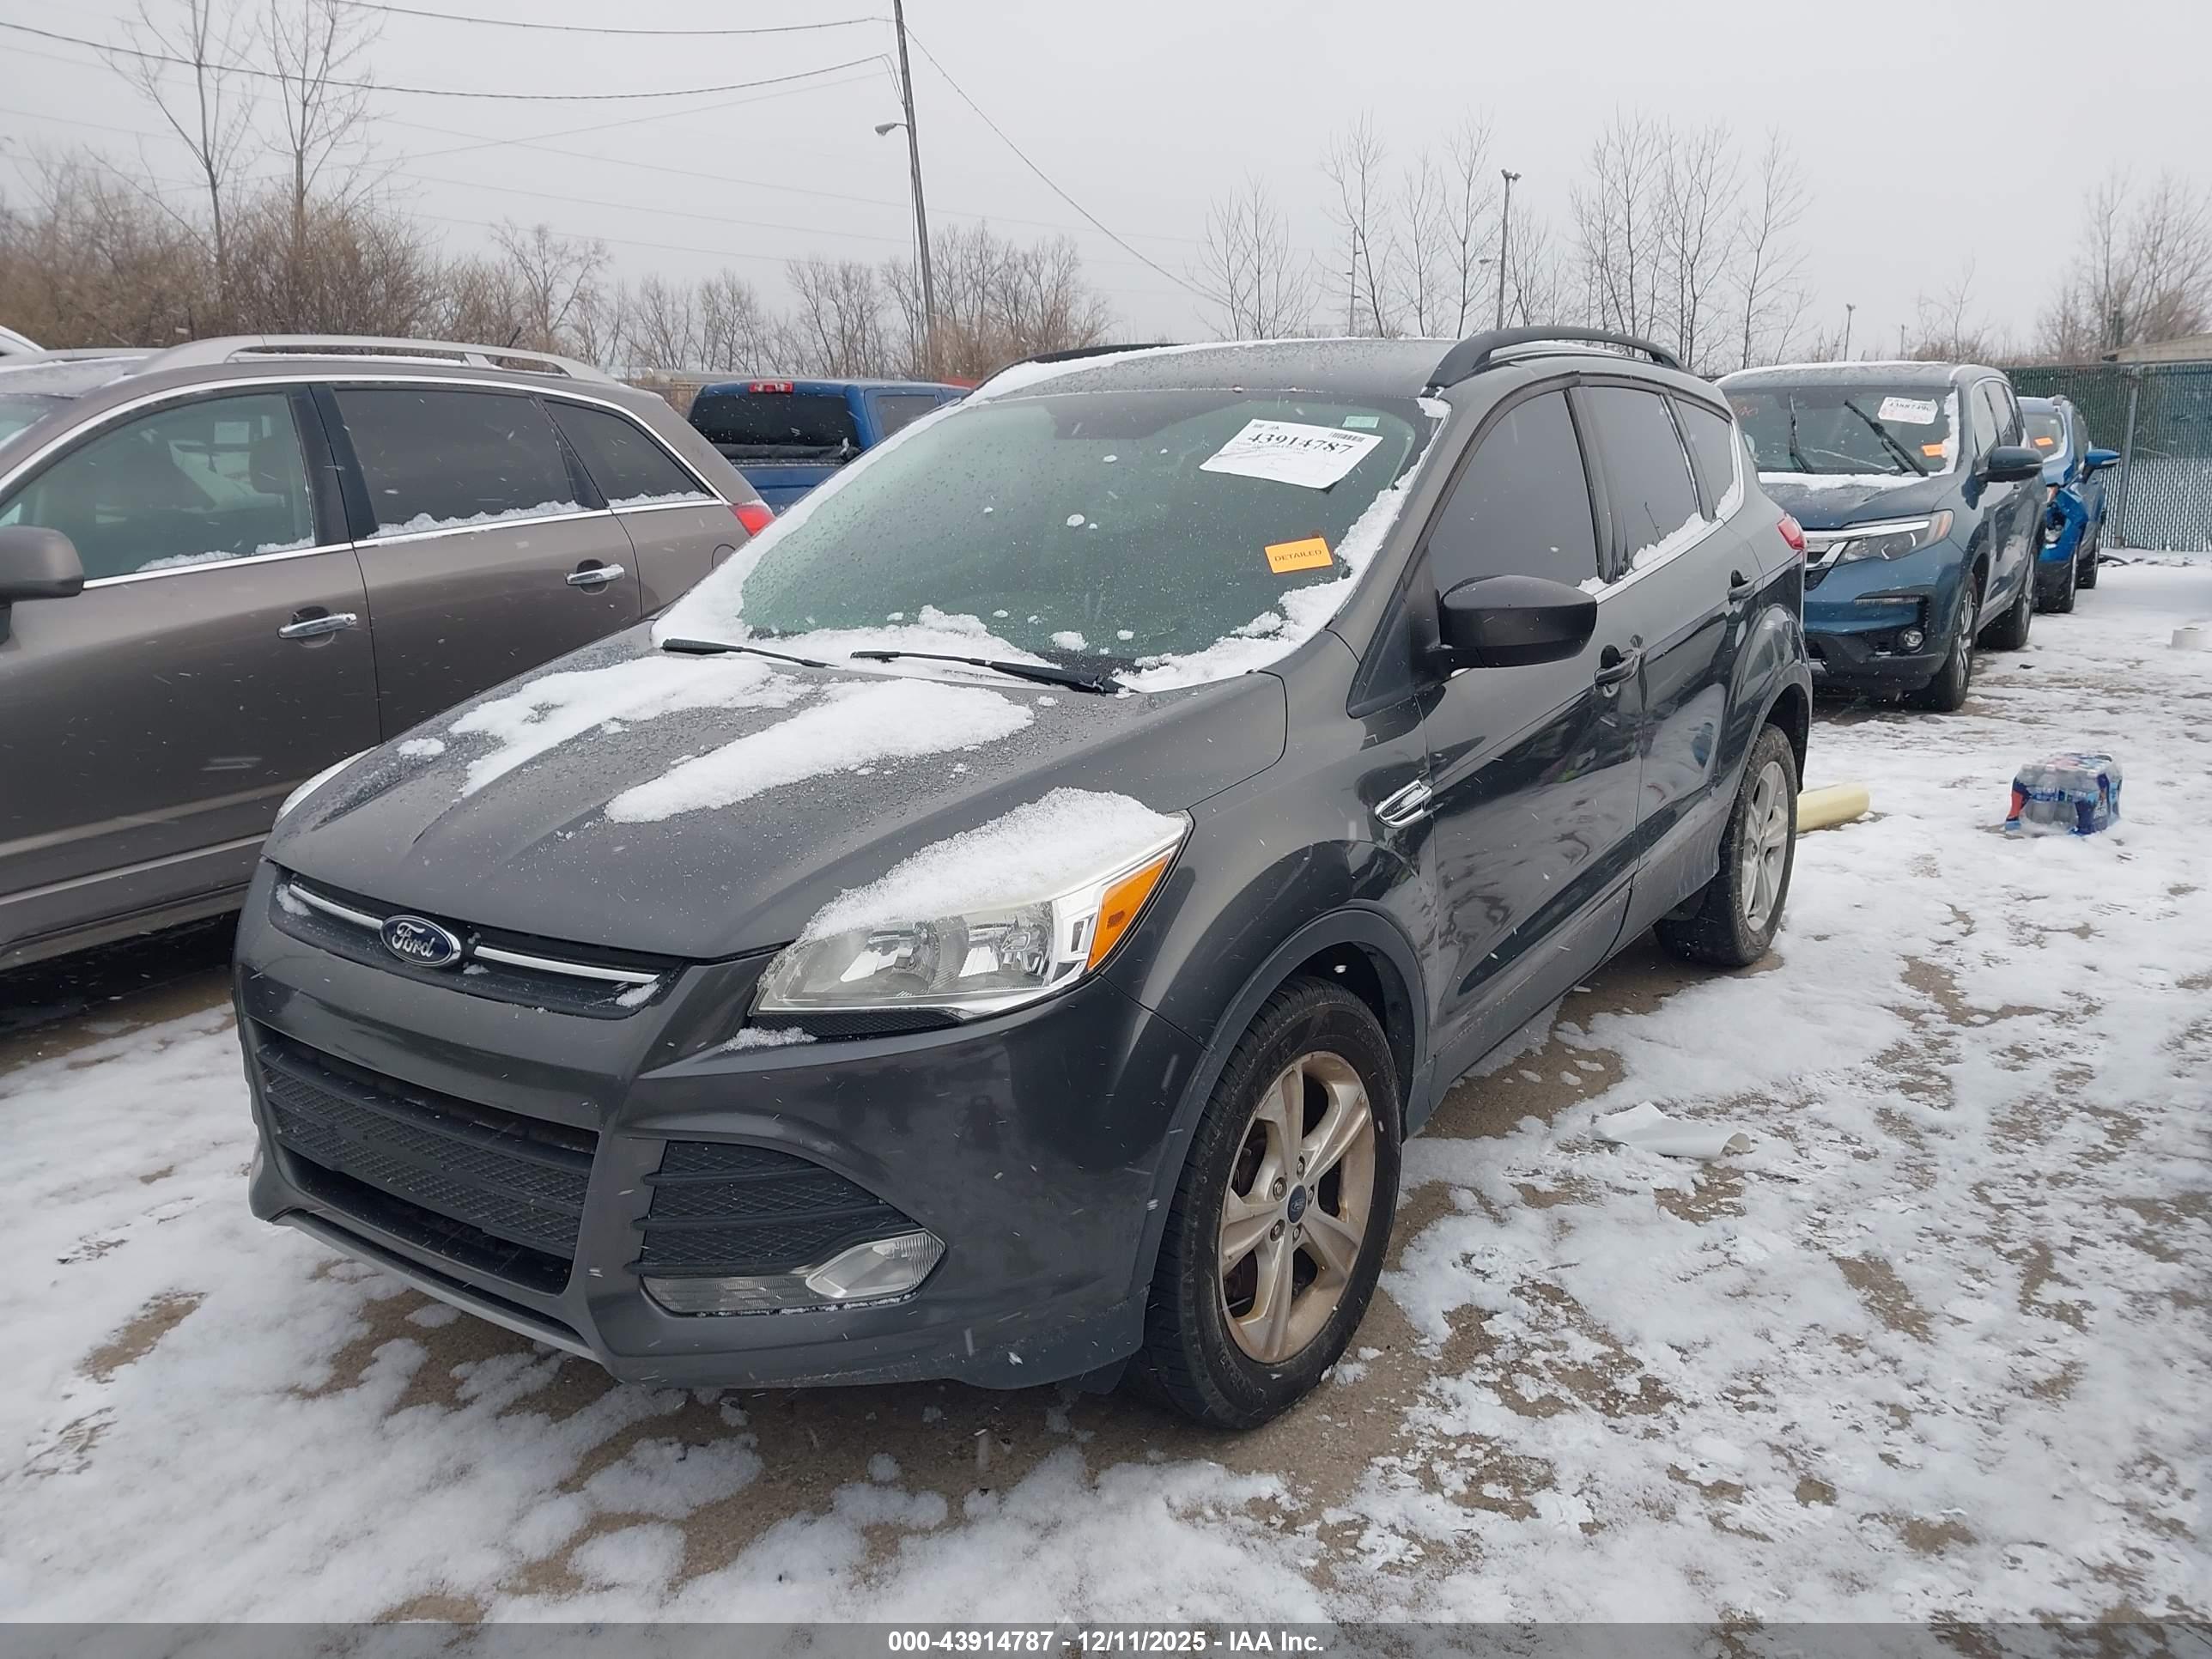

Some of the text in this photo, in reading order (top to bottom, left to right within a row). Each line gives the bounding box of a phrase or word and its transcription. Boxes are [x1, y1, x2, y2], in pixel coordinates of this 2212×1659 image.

[1249, 432, 1354, 454] 43914787
[1274, 550, 1322, 562] DETAILED
[392, 921, 435, 957] Ford
